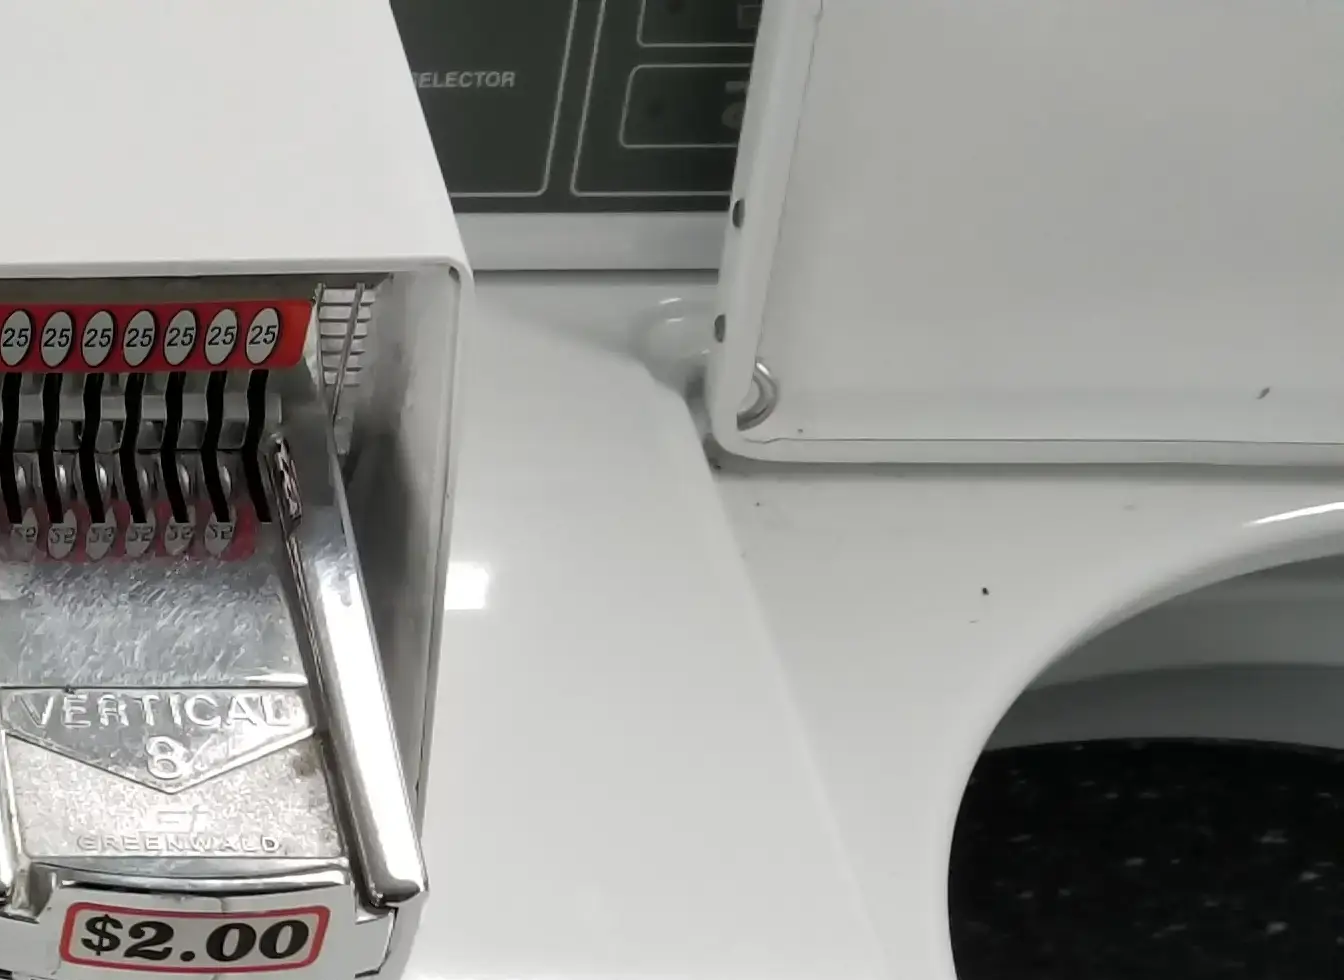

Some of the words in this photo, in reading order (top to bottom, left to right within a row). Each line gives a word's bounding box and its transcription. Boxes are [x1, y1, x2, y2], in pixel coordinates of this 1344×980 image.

[2, 327, 29, 348] 25
[43, 327, 71, 348] 25
[84, 327, 112, 348] 25
[126, 327, 153, 348] 25
[167, 326, 195, 347] 25
[208, 325, 236, 346] 25
[249, 325, 277, 345] 25
[14, 693, 296, 728] VERTICAL
[145, 735, 186, 780] 8
[76, 833, 281, 853] GREENWALD
[81, 914, 310, 963] $2.00
